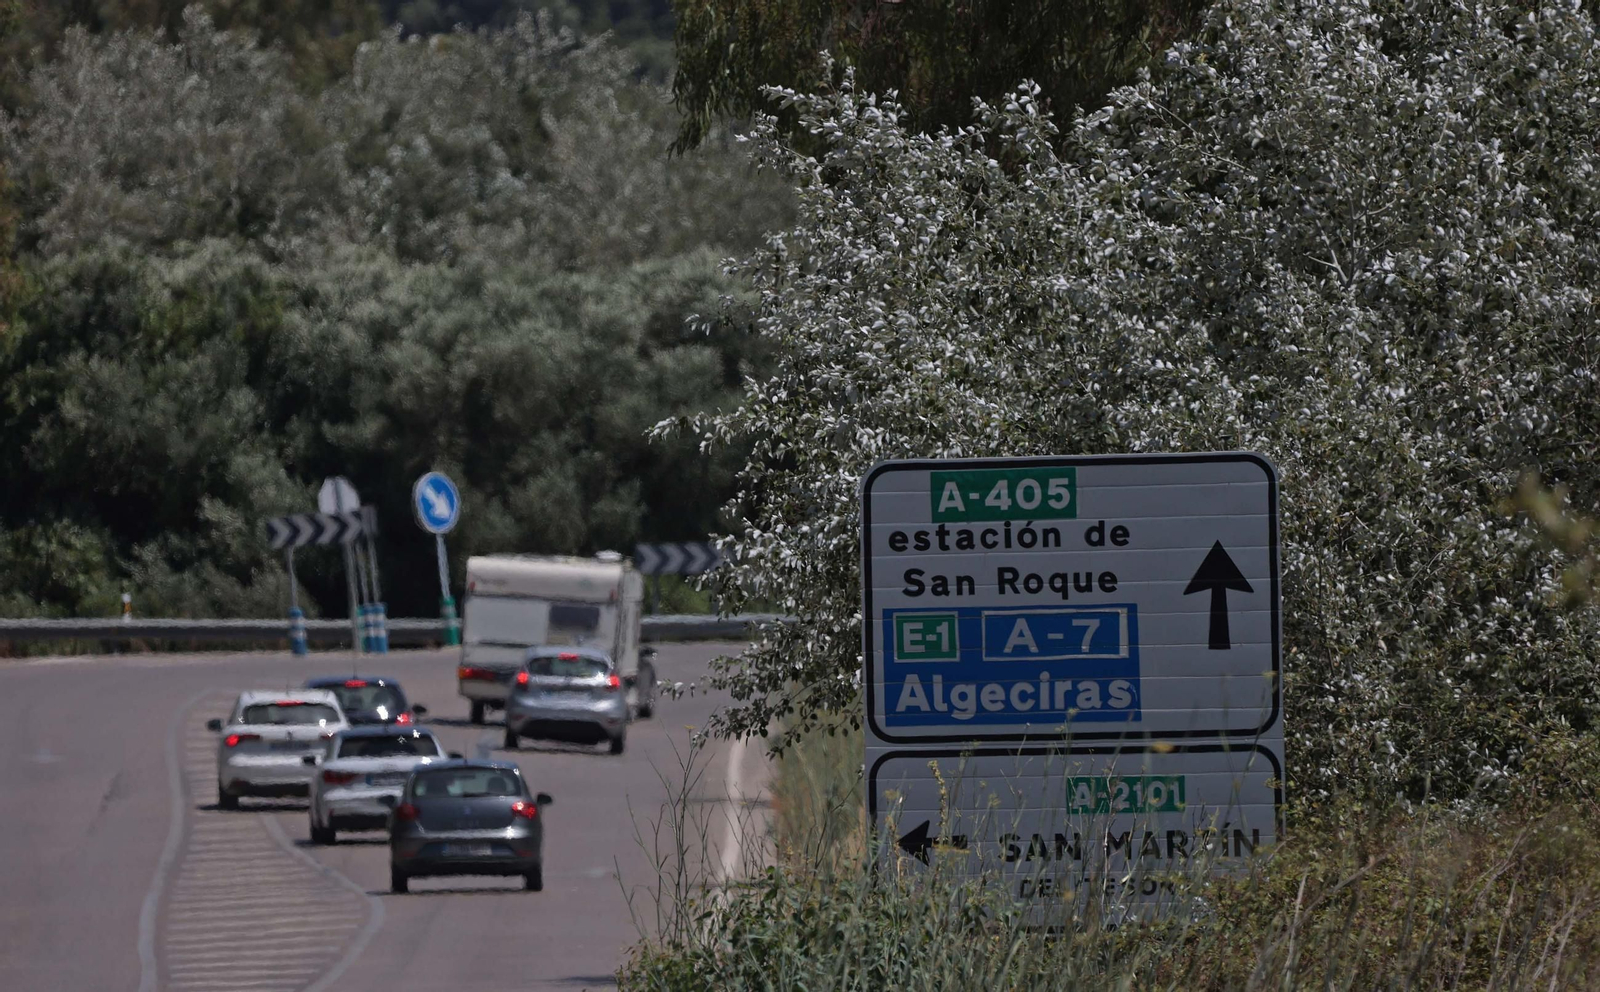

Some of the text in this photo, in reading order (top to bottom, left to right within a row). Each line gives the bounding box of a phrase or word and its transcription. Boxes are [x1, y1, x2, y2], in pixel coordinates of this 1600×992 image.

[938, 477, 1071, 513] A-405
[888, 520, 1131, 552] estación de
[902, 566, 1119, 600] San Roque
[902, 620, 950, 653] E-1
[896, 670, 1133, 720] Algeciras
[1072, 781, 1180, 811] A-2101
[998, 833, 1082, 862] SAN
